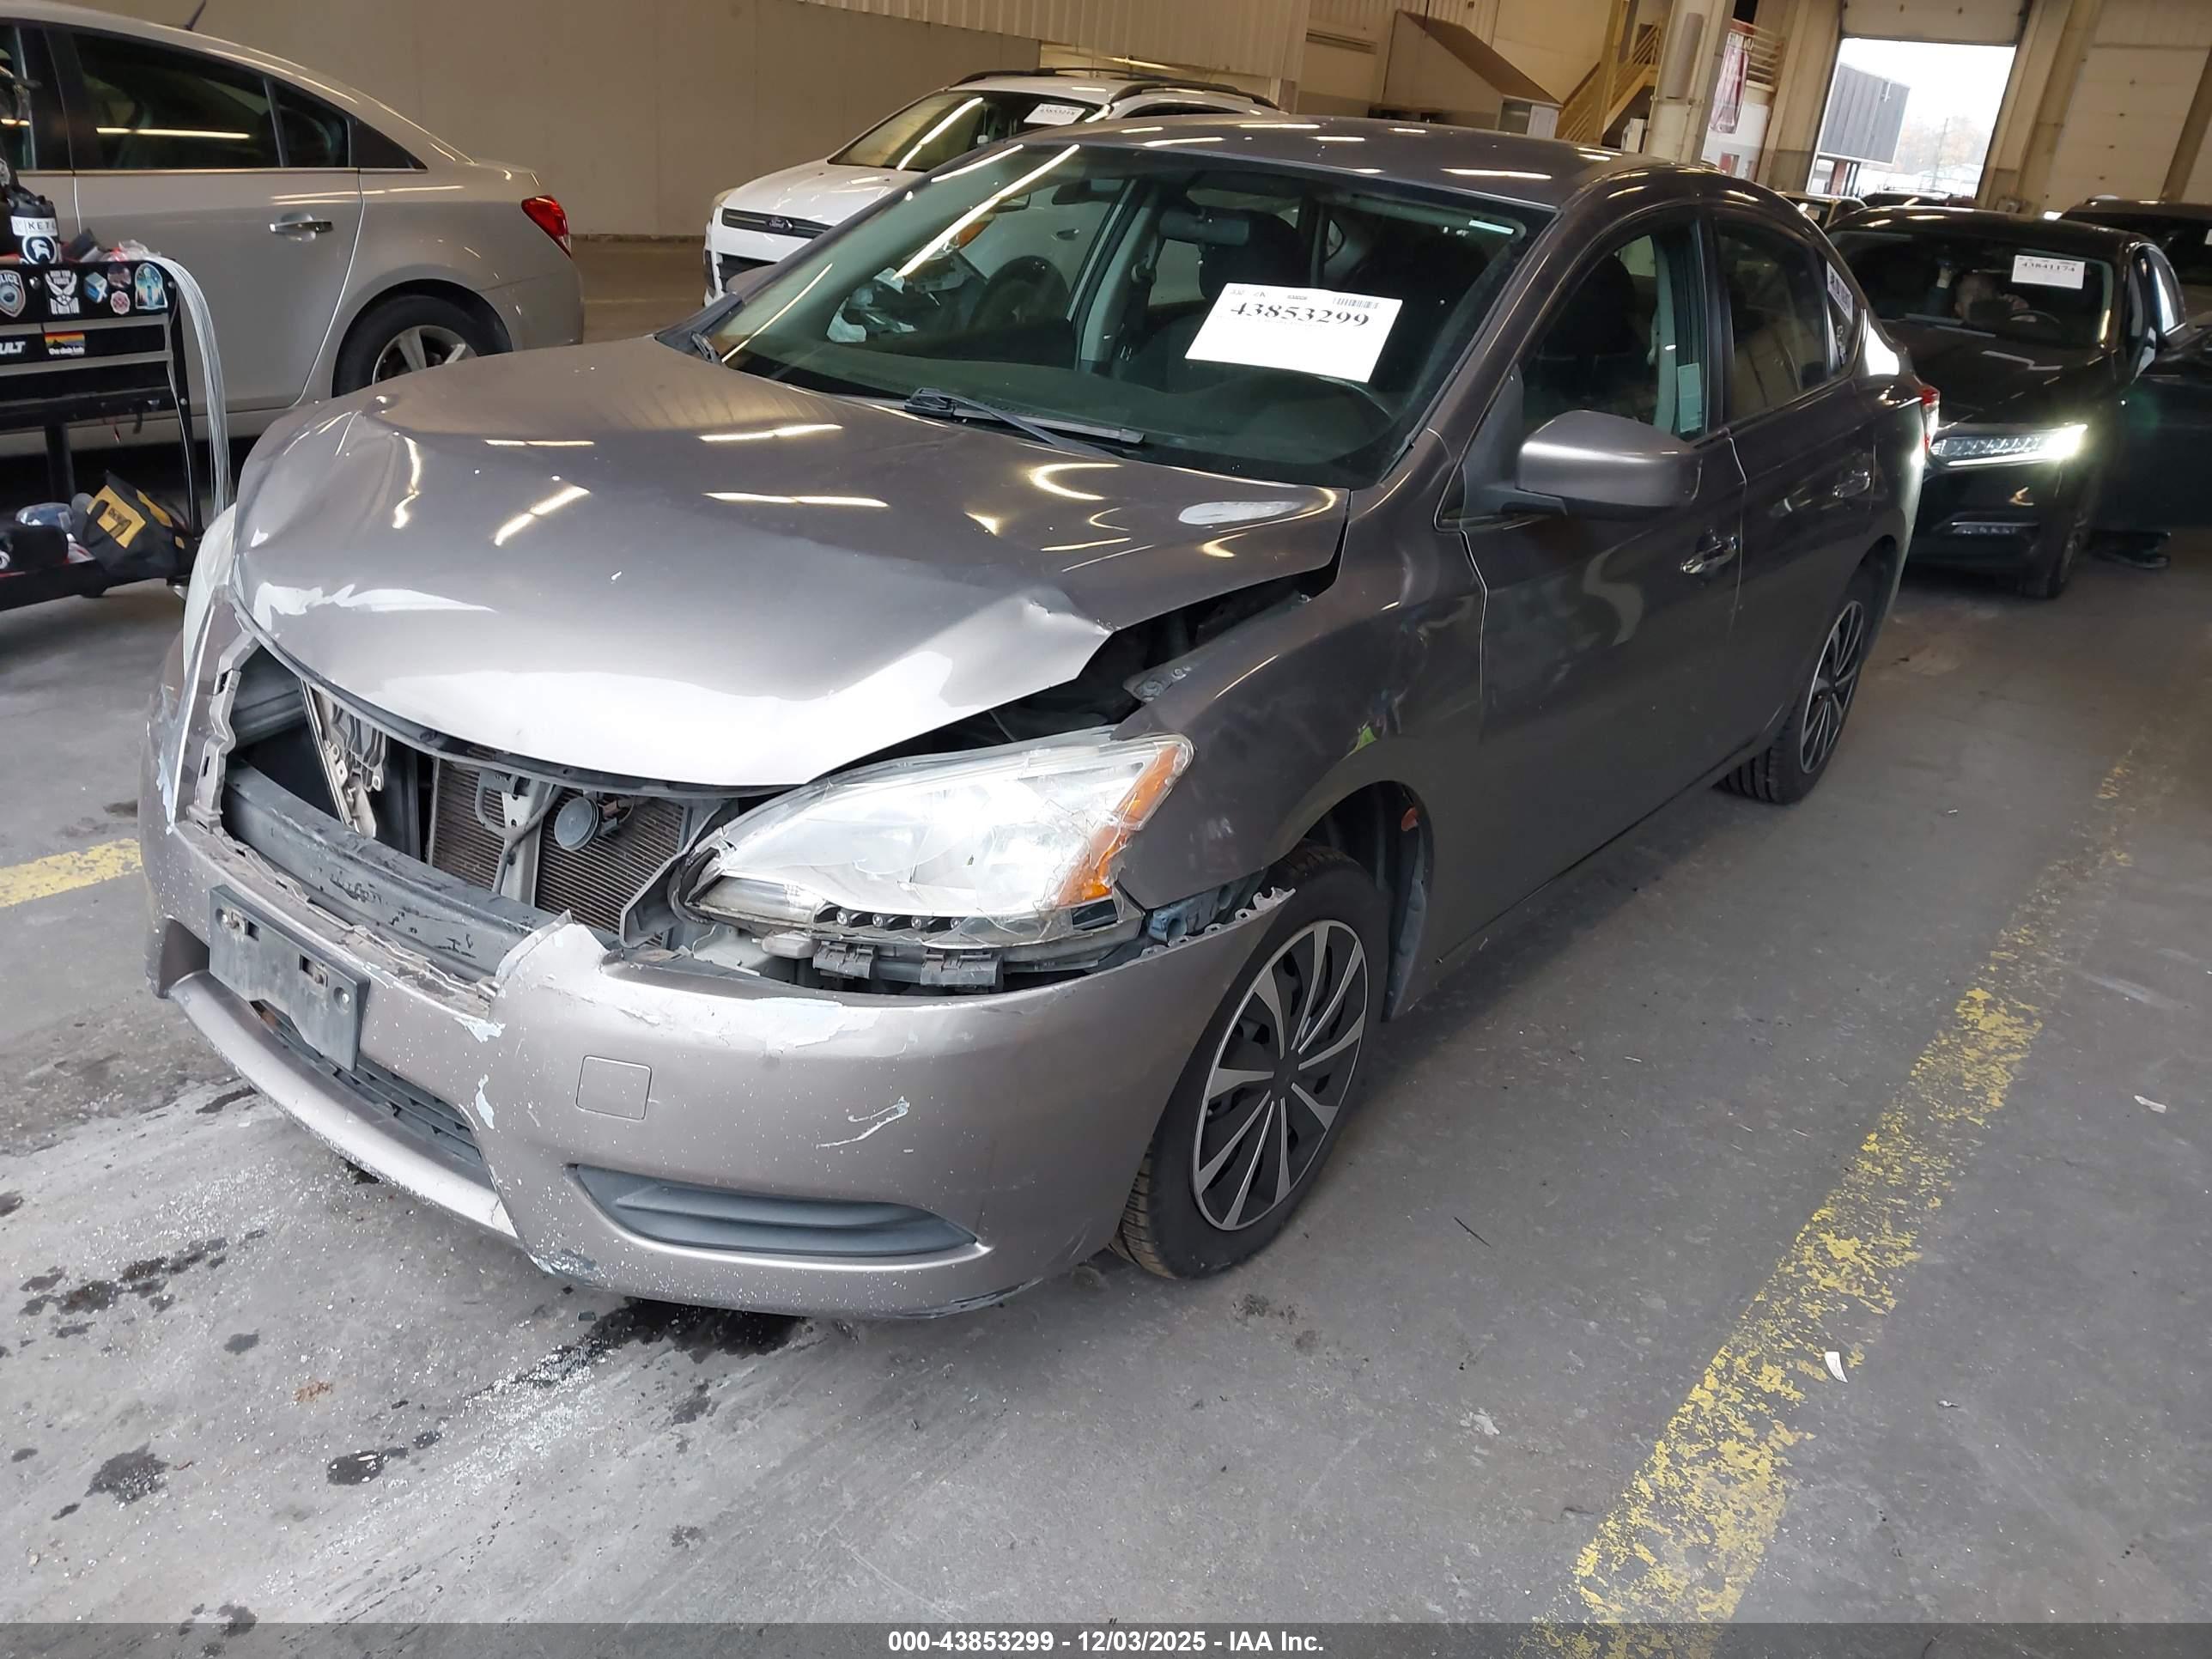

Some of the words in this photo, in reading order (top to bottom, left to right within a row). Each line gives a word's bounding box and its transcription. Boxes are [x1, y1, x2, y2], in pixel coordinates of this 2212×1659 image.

[0, 273, 20, 285] LICE
[1231, 301, 1370, 327] 43853299
[0, 341, 26, 355] ULT
